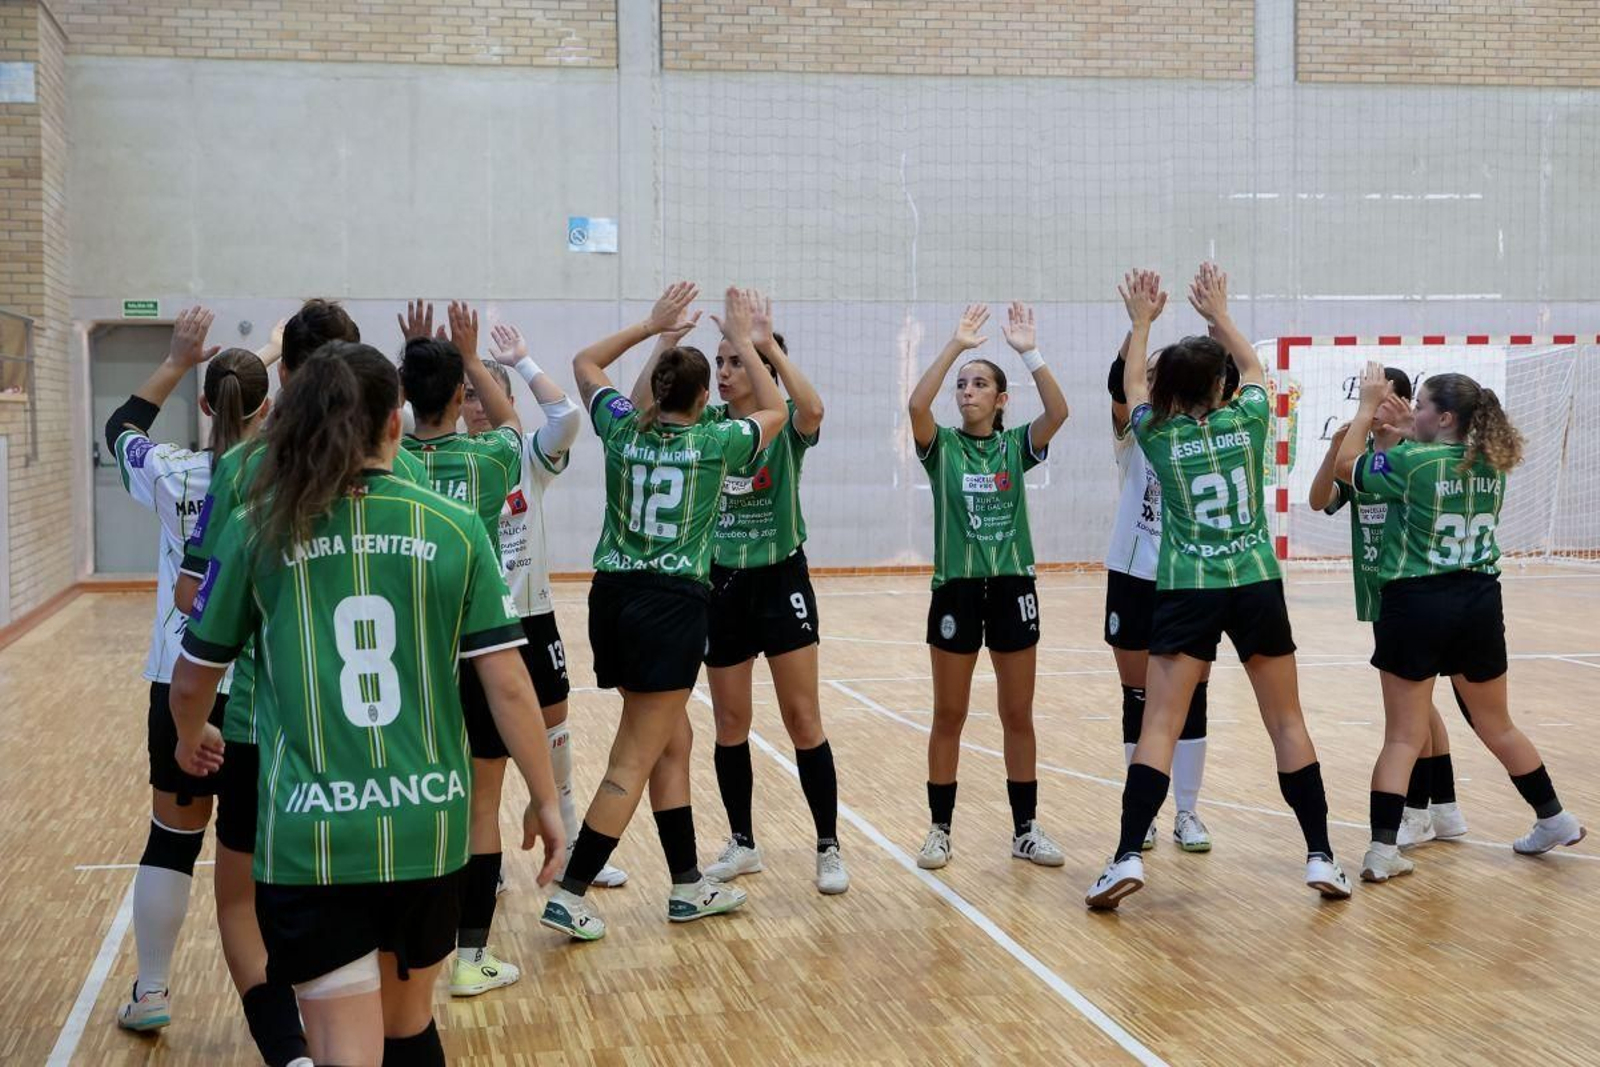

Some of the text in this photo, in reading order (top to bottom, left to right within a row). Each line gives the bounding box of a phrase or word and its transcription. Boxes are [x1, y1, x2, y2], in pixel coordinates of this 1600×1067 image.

[628, 464, 684, 538] 12
[1191, 466, 1251, 529] 21
[282, 534, 437, 567] LAURA CENTENO
[1428, 513, 1496, 566] 30
[790, 592, 808, 619] 9
[1017, 593, 1037, 622] 18
[333, 595, 401, 728] 8
[547, 640, 565, 670] 13
